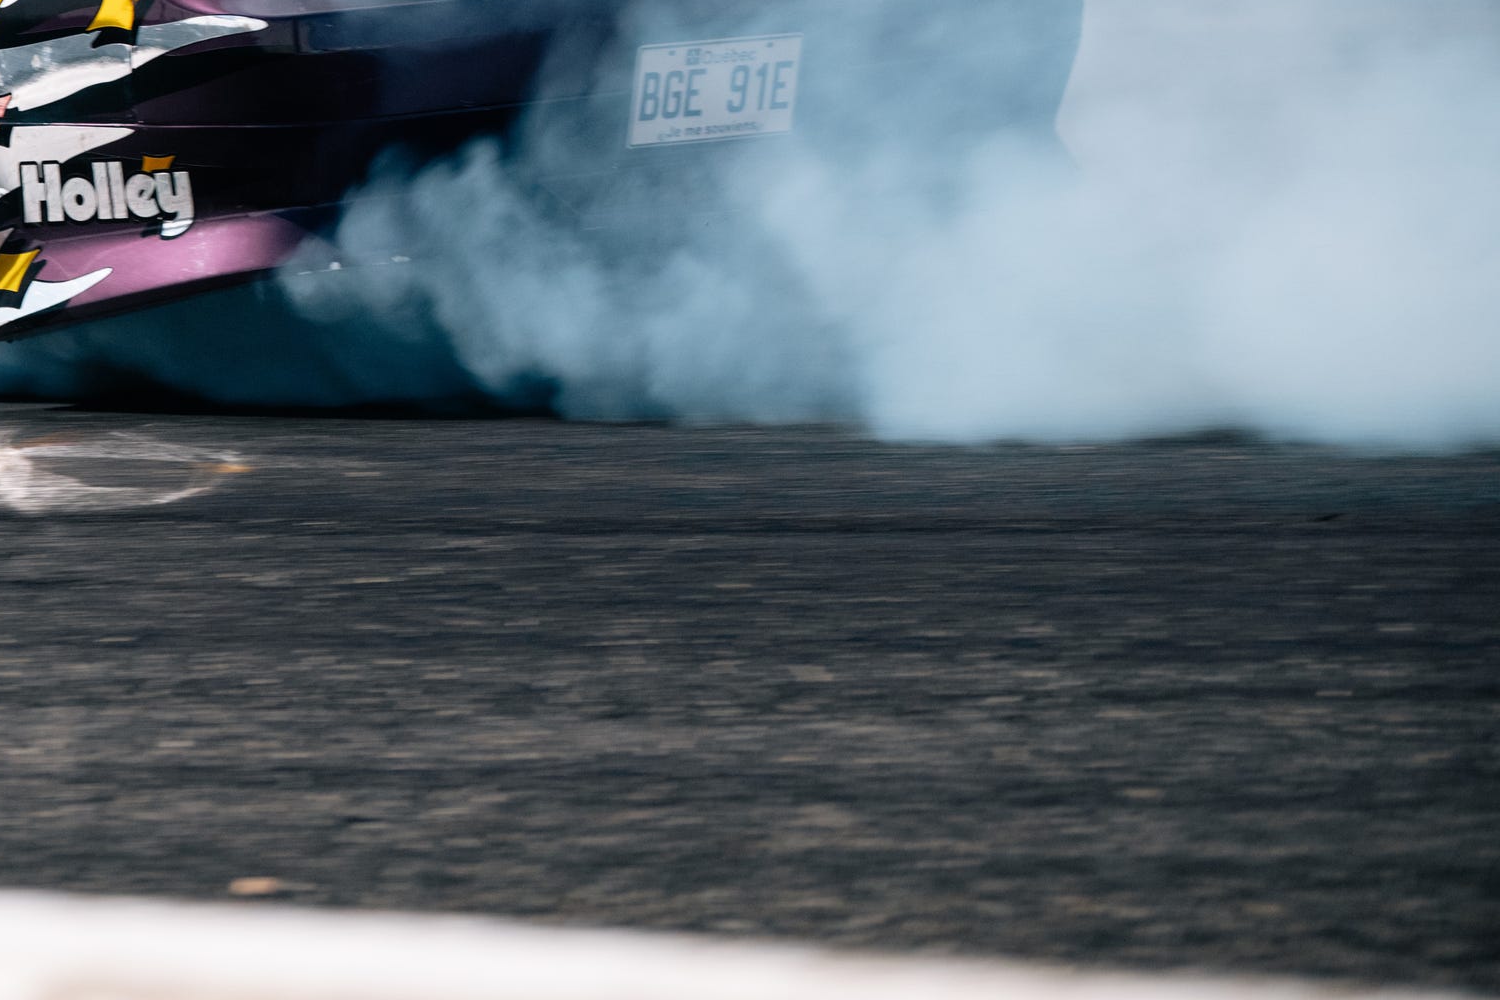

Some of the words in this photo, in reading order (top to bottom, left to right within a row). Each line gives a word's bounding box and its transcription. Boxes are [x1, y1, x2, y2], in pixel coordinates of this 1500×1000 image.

[638, 68, 707, 121] BGE
[726, 60, 795, 113] 91E
[20, 161, 195, 238] Holley
